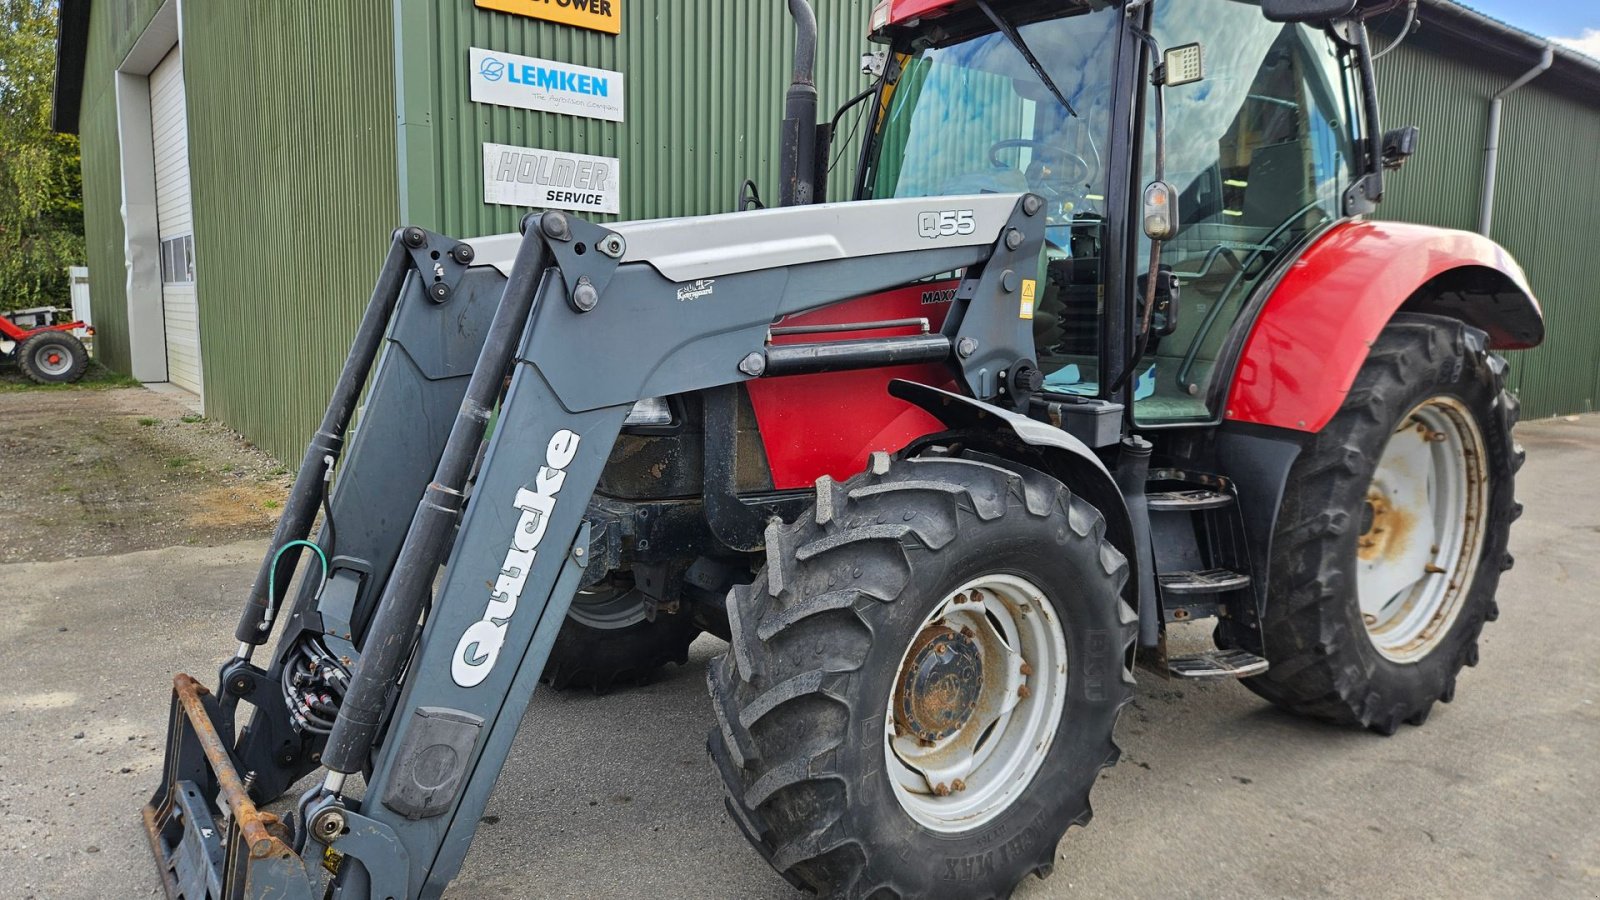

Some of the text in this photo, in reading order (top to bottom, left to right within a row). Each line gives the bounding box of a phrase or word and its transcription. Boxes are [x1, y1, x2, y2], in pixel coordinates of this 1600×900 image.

[508, 62, 608, 97] LEMKEN
[532, 93, 546, 101] The
[496, 151, 609, 191] HOLMER
[546, 190, 603, 206] SERVICE
[918, 209, 976, 239] Q55
[450, 429, 580, 688] Quicke
